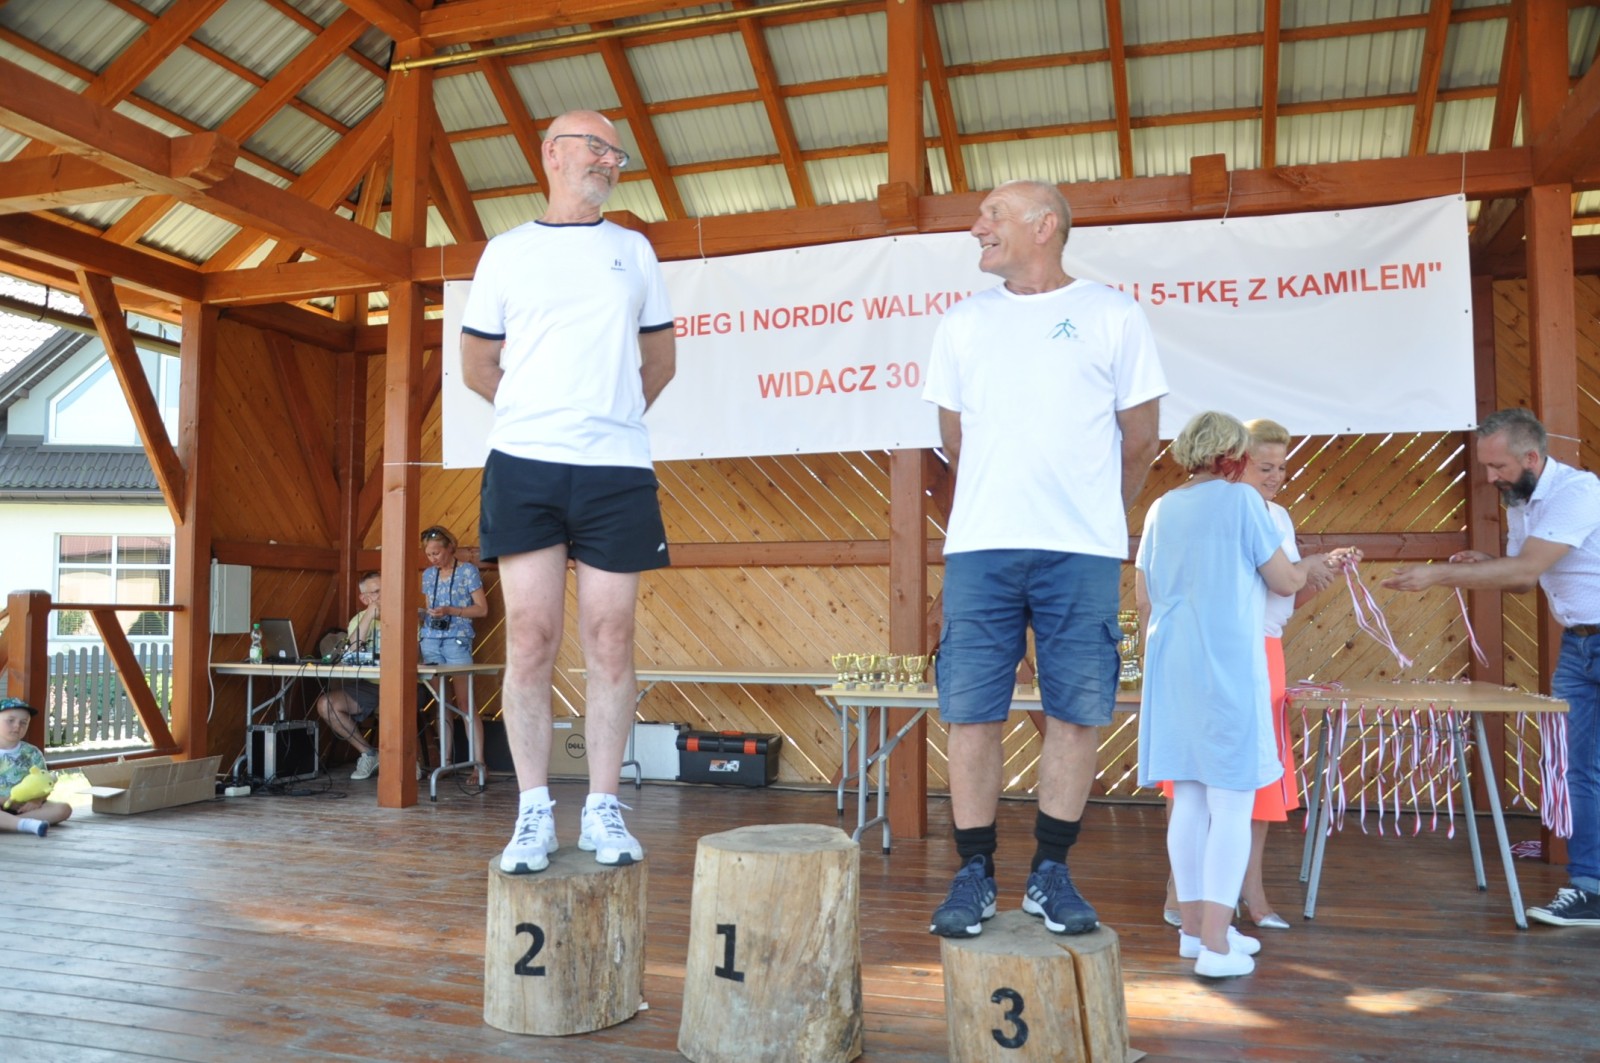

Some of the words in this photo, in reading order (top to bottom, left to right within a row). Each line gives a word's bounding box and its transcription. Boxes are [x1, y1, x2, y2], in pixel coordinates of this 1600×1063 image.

[674, 312, 732, 338] BIEG
[739, 310, 745, 333] I
[753, 299, 854, 331] NORDIC
[1151, 279, 1239, 308] 5-TKĘ
[1247, 278, 1268, 301] Z
[1276, 261, 1443, 299] KAMILEM"
[758, 363, 877, 399] WIDACZ
[886, 361, 926, 389] 30
[514, 922, 545, 976] 2
[714, 924, 745, 982] 1
[991, 987, 1029, 1049] 3
